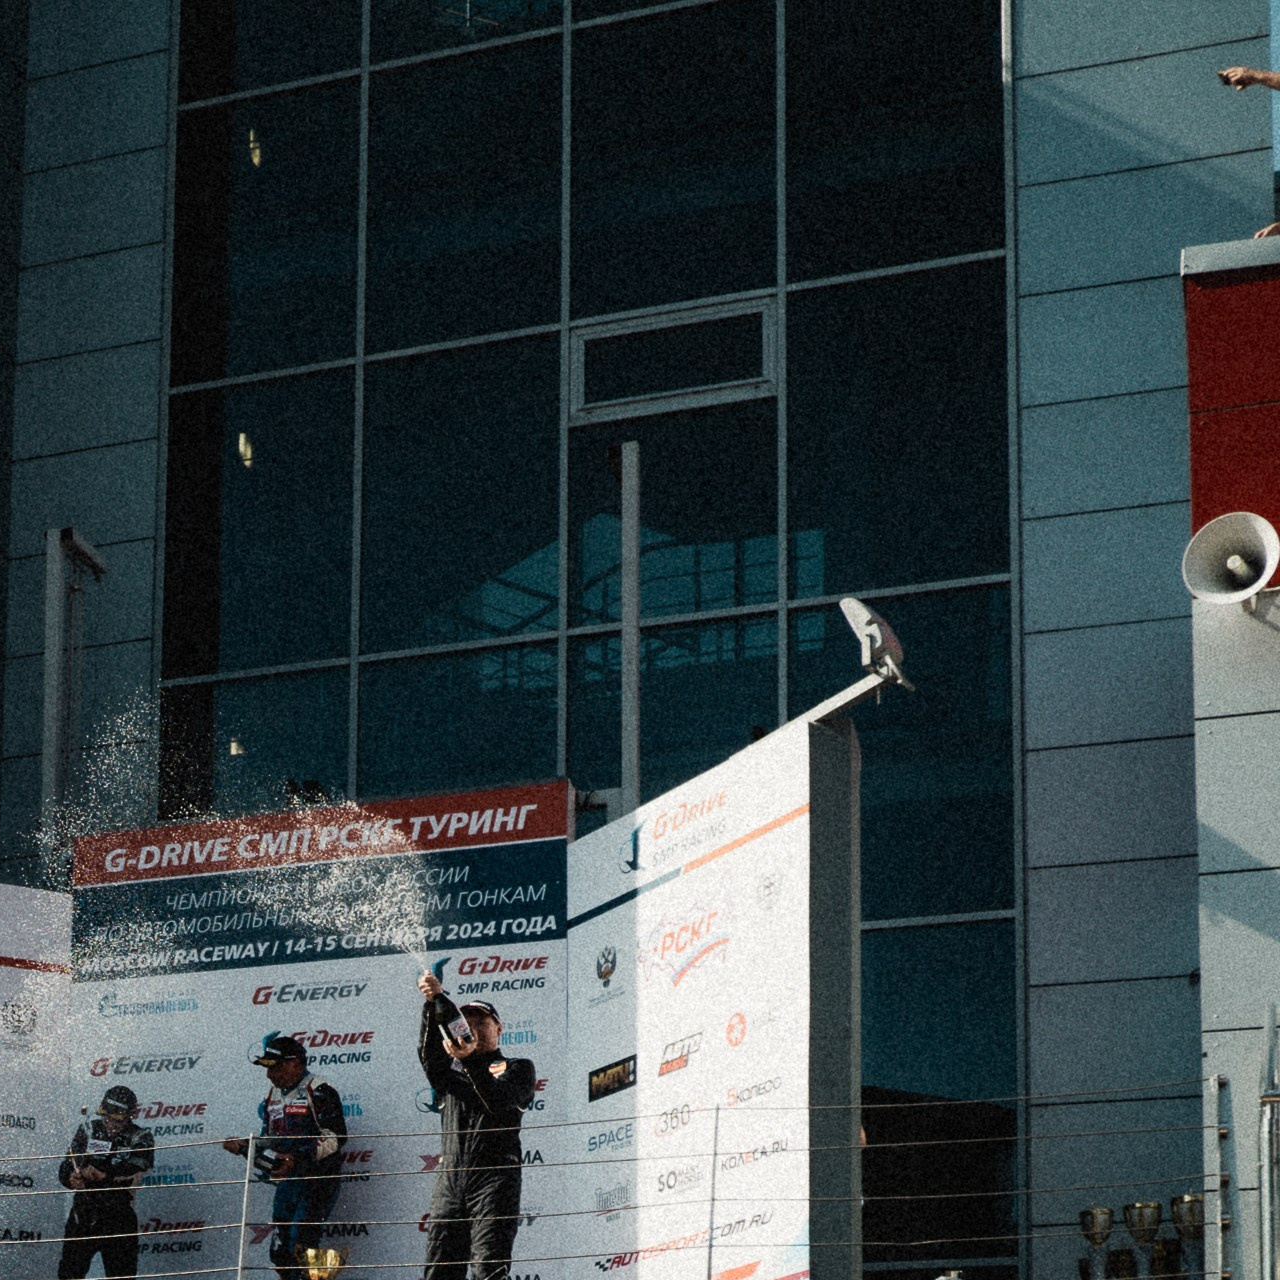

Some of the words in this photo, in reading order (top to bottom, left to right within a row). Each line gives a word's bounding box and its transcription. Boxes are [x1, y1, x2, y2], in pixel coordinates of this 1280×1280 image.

[105, 837, 231, 872] G-DRIVE
[237, 827, 312, 858] СМП
[409, 804, 538, 841] ТУРИНГ
[386, 866, 469, 893] ОССИИ
[456, 884, 547, 909] ГОНКАМ
[82, 950, 169, 973] MOSCOW
[173, 942, 270, 965] RACEWAY
[285, 935, 337, 955] 14-15
[445, 922, 496, 940] 2024
[500, 915, 557, 935] ГОДА
[457, 981, 489, 995] SMP
[491, 977, 546, 992] RACING
[319, 1051, 371, 1066] RACING
[154, 1123, 204, 1136] RACING
[588, 1123, 634, 1152] SPACE
[658, 1170, 678, 1193] SO
[152, 1240, 203, 1254] RACING
